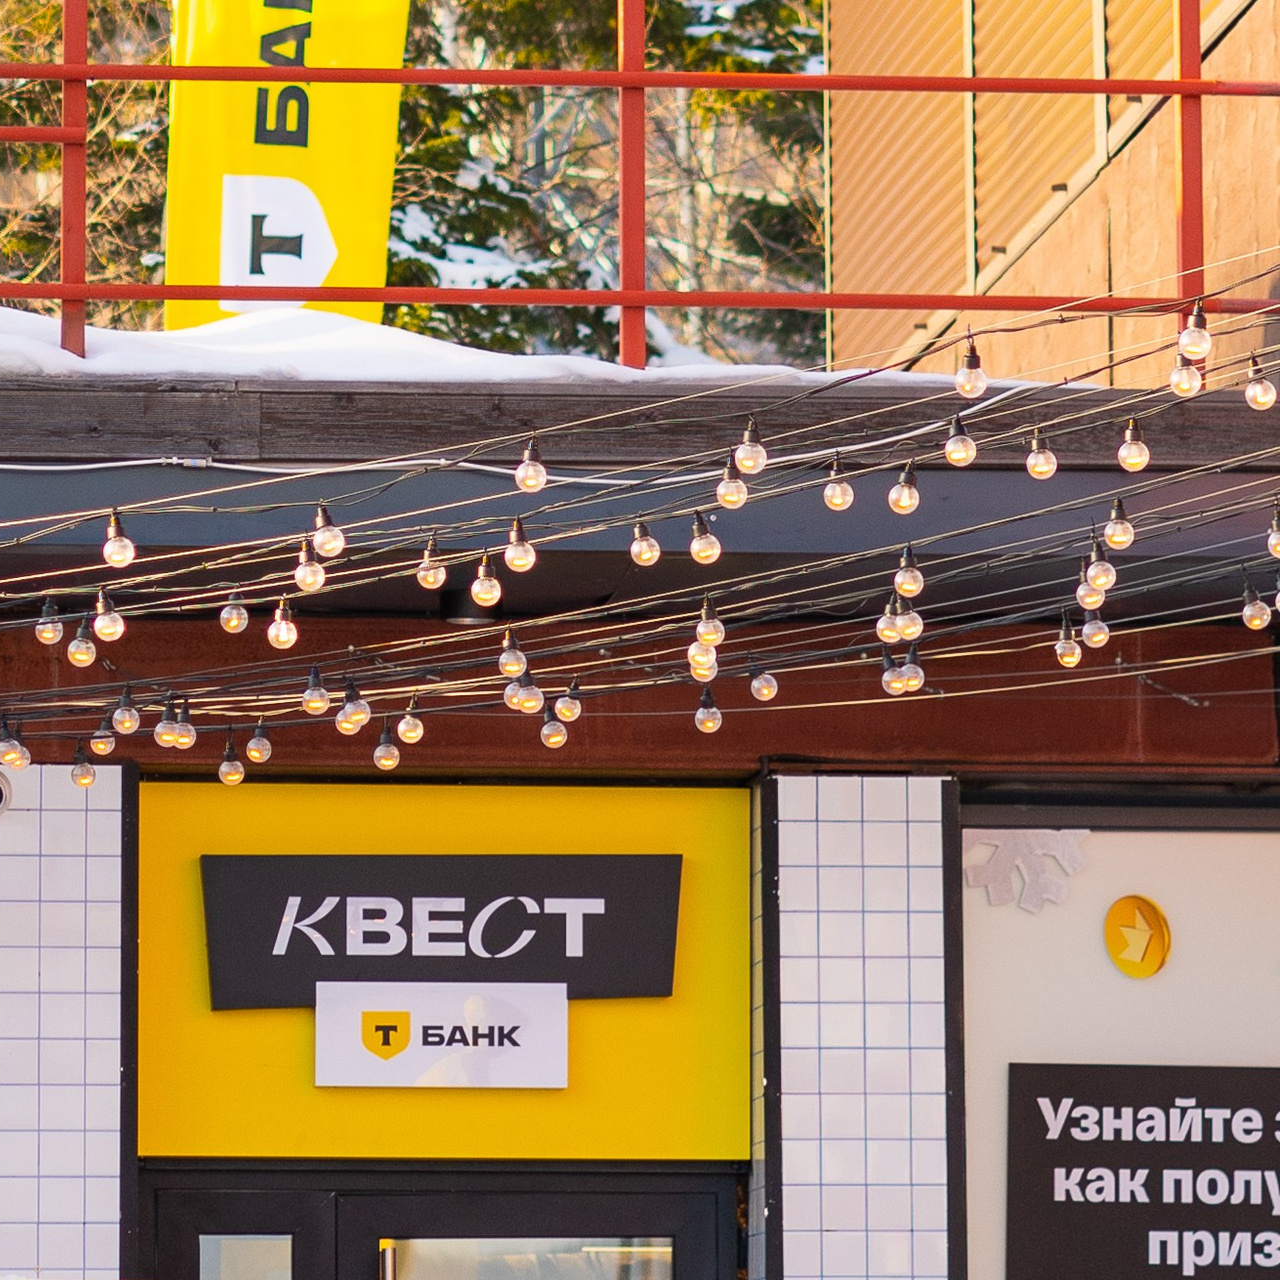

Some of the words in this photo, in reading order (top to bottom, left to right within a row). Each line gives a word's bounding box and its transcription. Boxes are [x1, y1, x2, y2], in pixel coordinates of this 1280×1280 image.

[272, 895, 606, 959] КВЕСТ
[375, 1024, 398, 1047] Т
[421, 1024, 522, 1048] БАНК
[1036, 1096, 1263, 1144] Узнайте
[1053, 1166, 1150, 1203] как
[1147, 1228, 1280, 1276] приз
